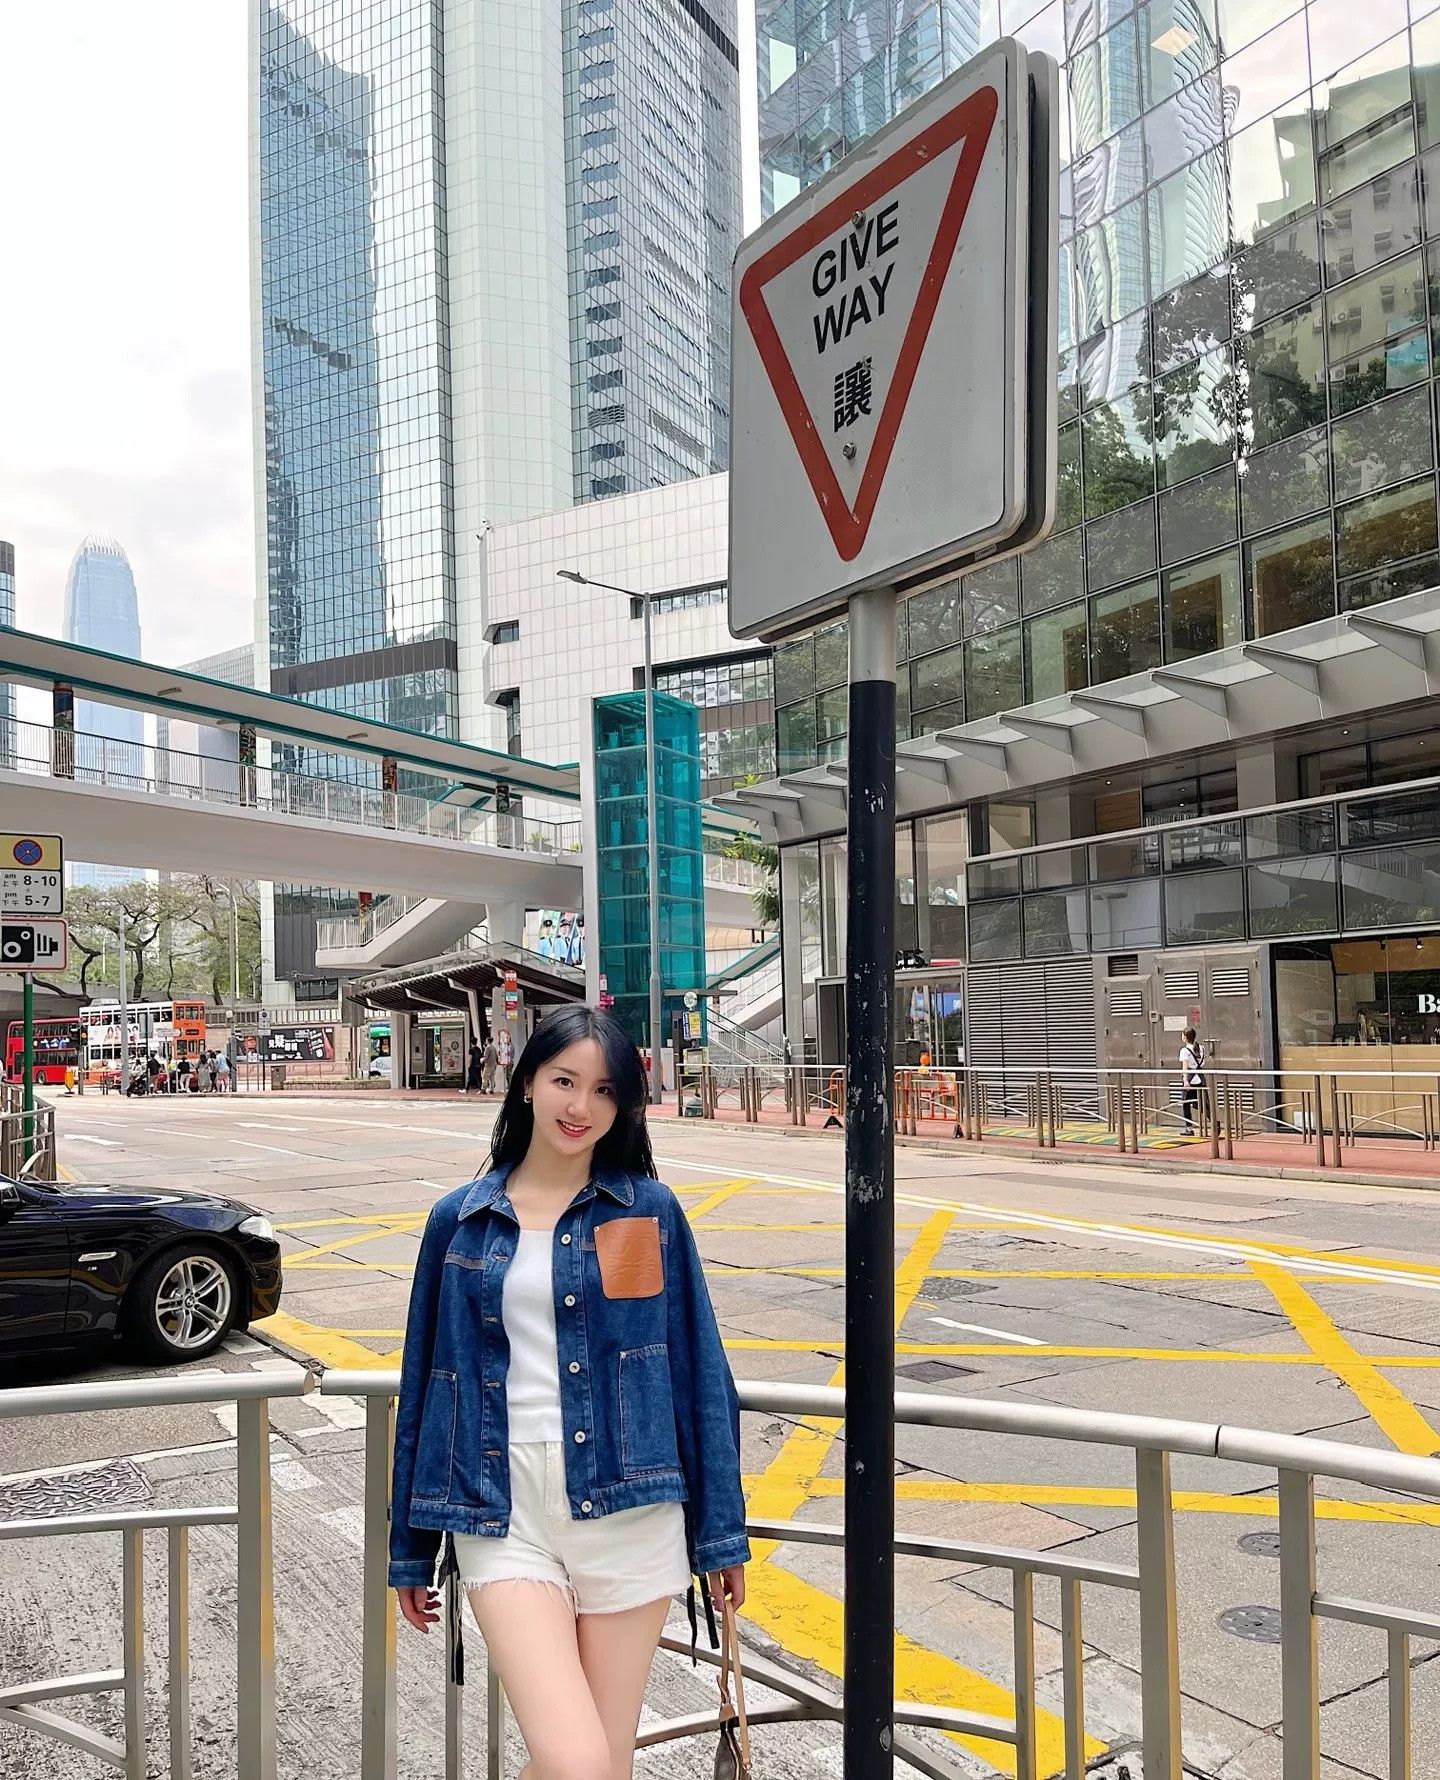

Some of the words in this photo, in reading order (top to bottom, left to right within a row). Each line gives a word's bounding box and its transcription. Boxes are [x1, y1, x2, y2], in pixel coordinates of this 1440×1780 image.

[813, 200, 899, 298] GIVE
[813, 262, 895, 355] WAY
[833, 356, 872, 434] 讓
